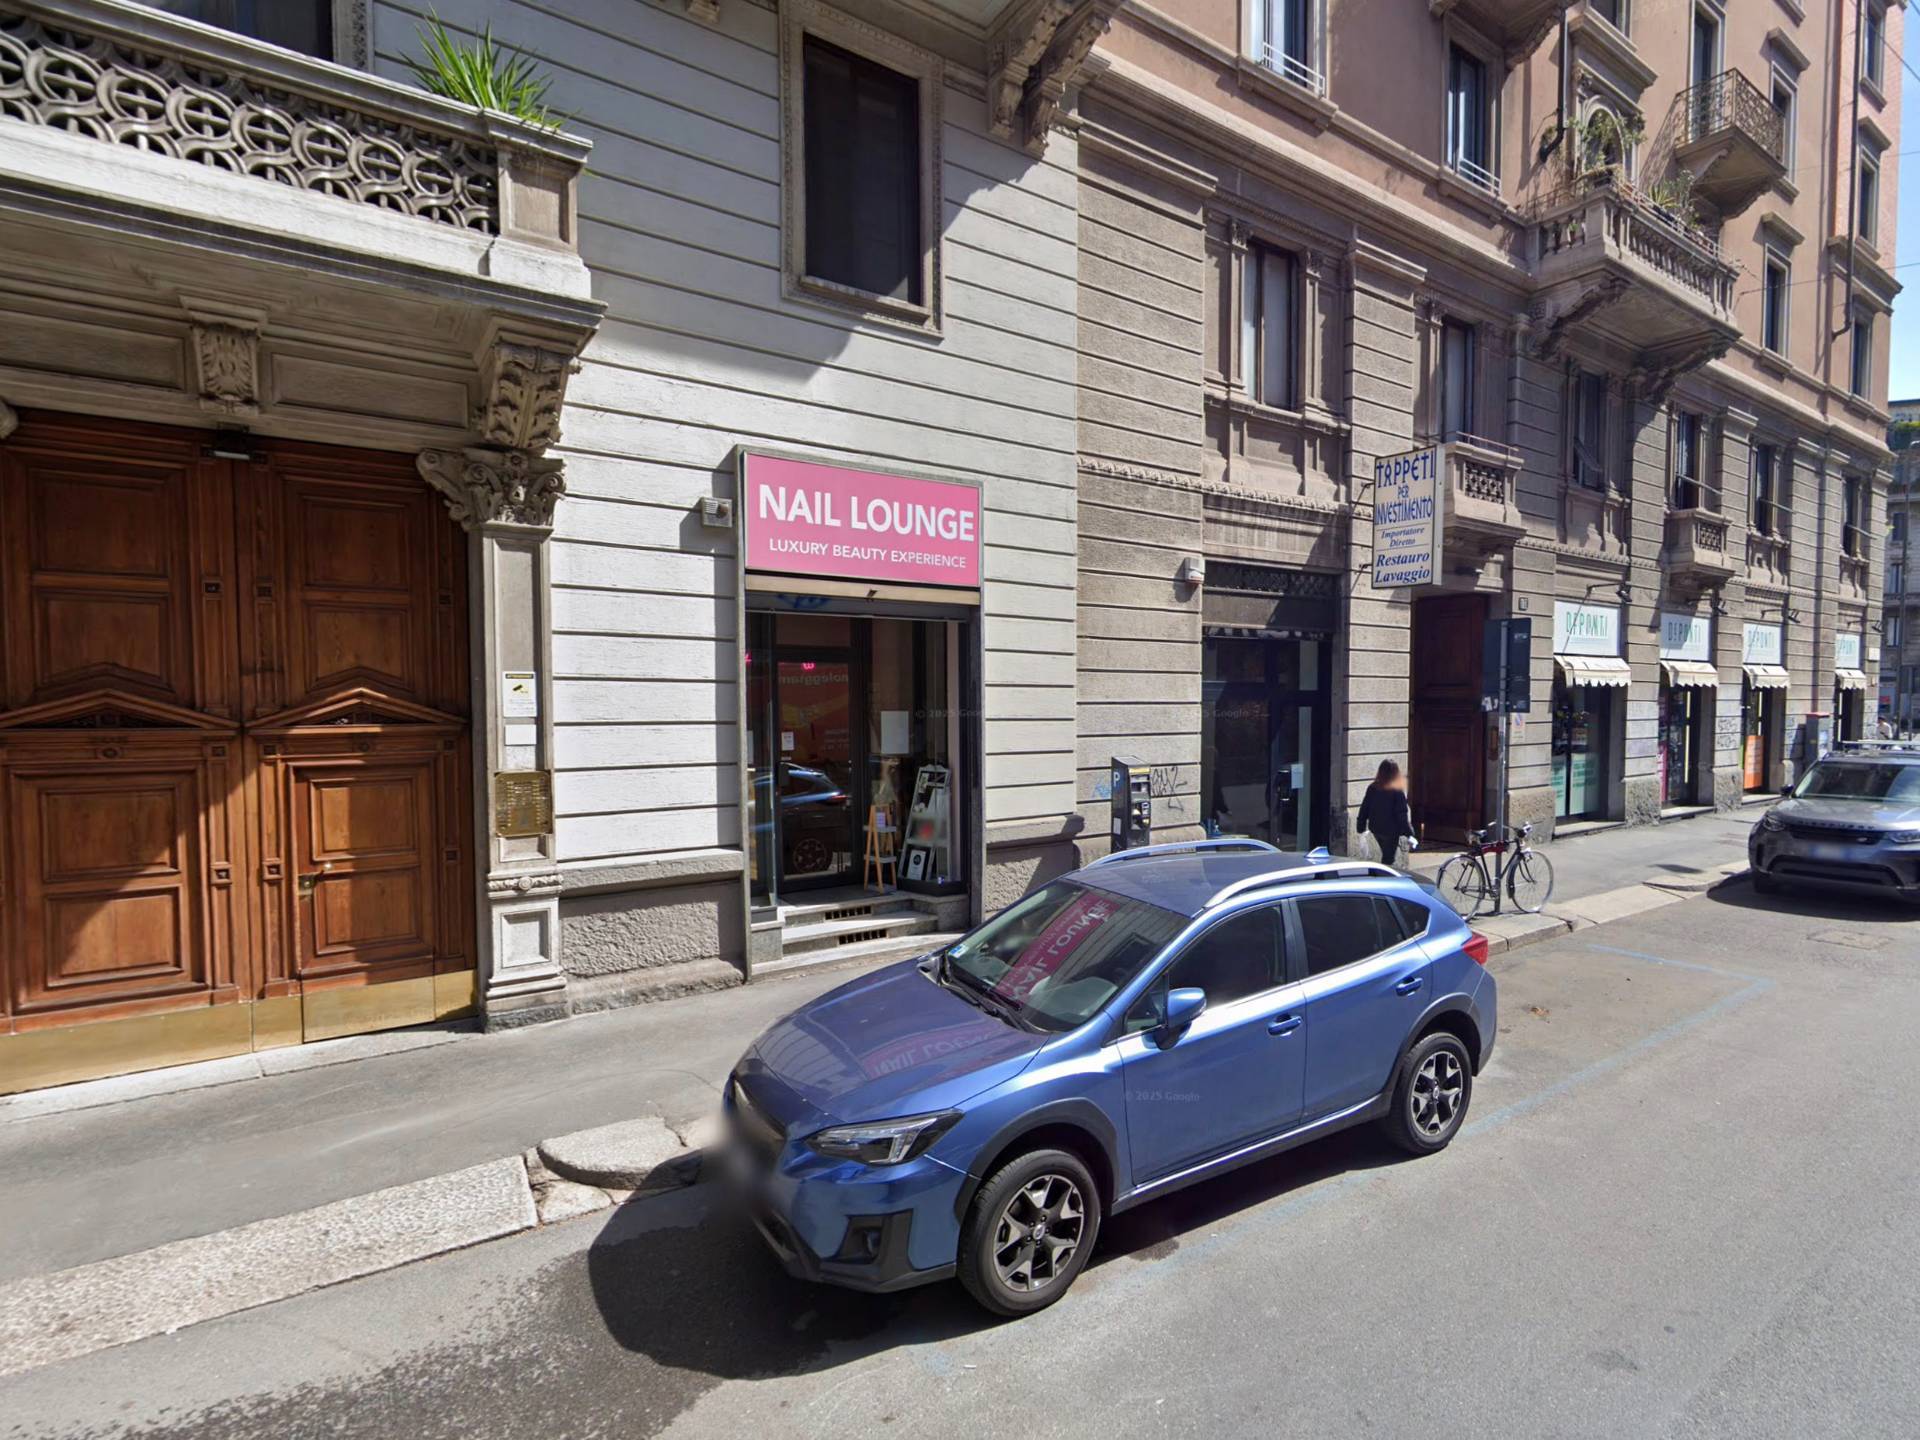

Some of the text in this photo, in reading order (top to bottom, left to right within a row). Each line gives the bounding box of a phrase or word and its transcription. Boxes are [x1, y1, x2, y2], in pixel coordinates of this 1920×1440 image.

[1376, 450, 1434, 488] TAPPETI
[1397, 485, 1409, 499] PER
[759, 484, 974, 542] NAIL LOUNGE
[1375, 499, 1433, 525] INVESTIMENTO
[1381, 526, 1425, 539] Importatore
[1389, 538, 1416, 548] Diretto
[769, 538, 967, 569] LUXURY BEAUTY EXPERIENCE
[1376, 551, 1430, 568] Restauro
[1374, 566, 1430, 584] Lavaggio
[1113, 771, 1121, 787] P
